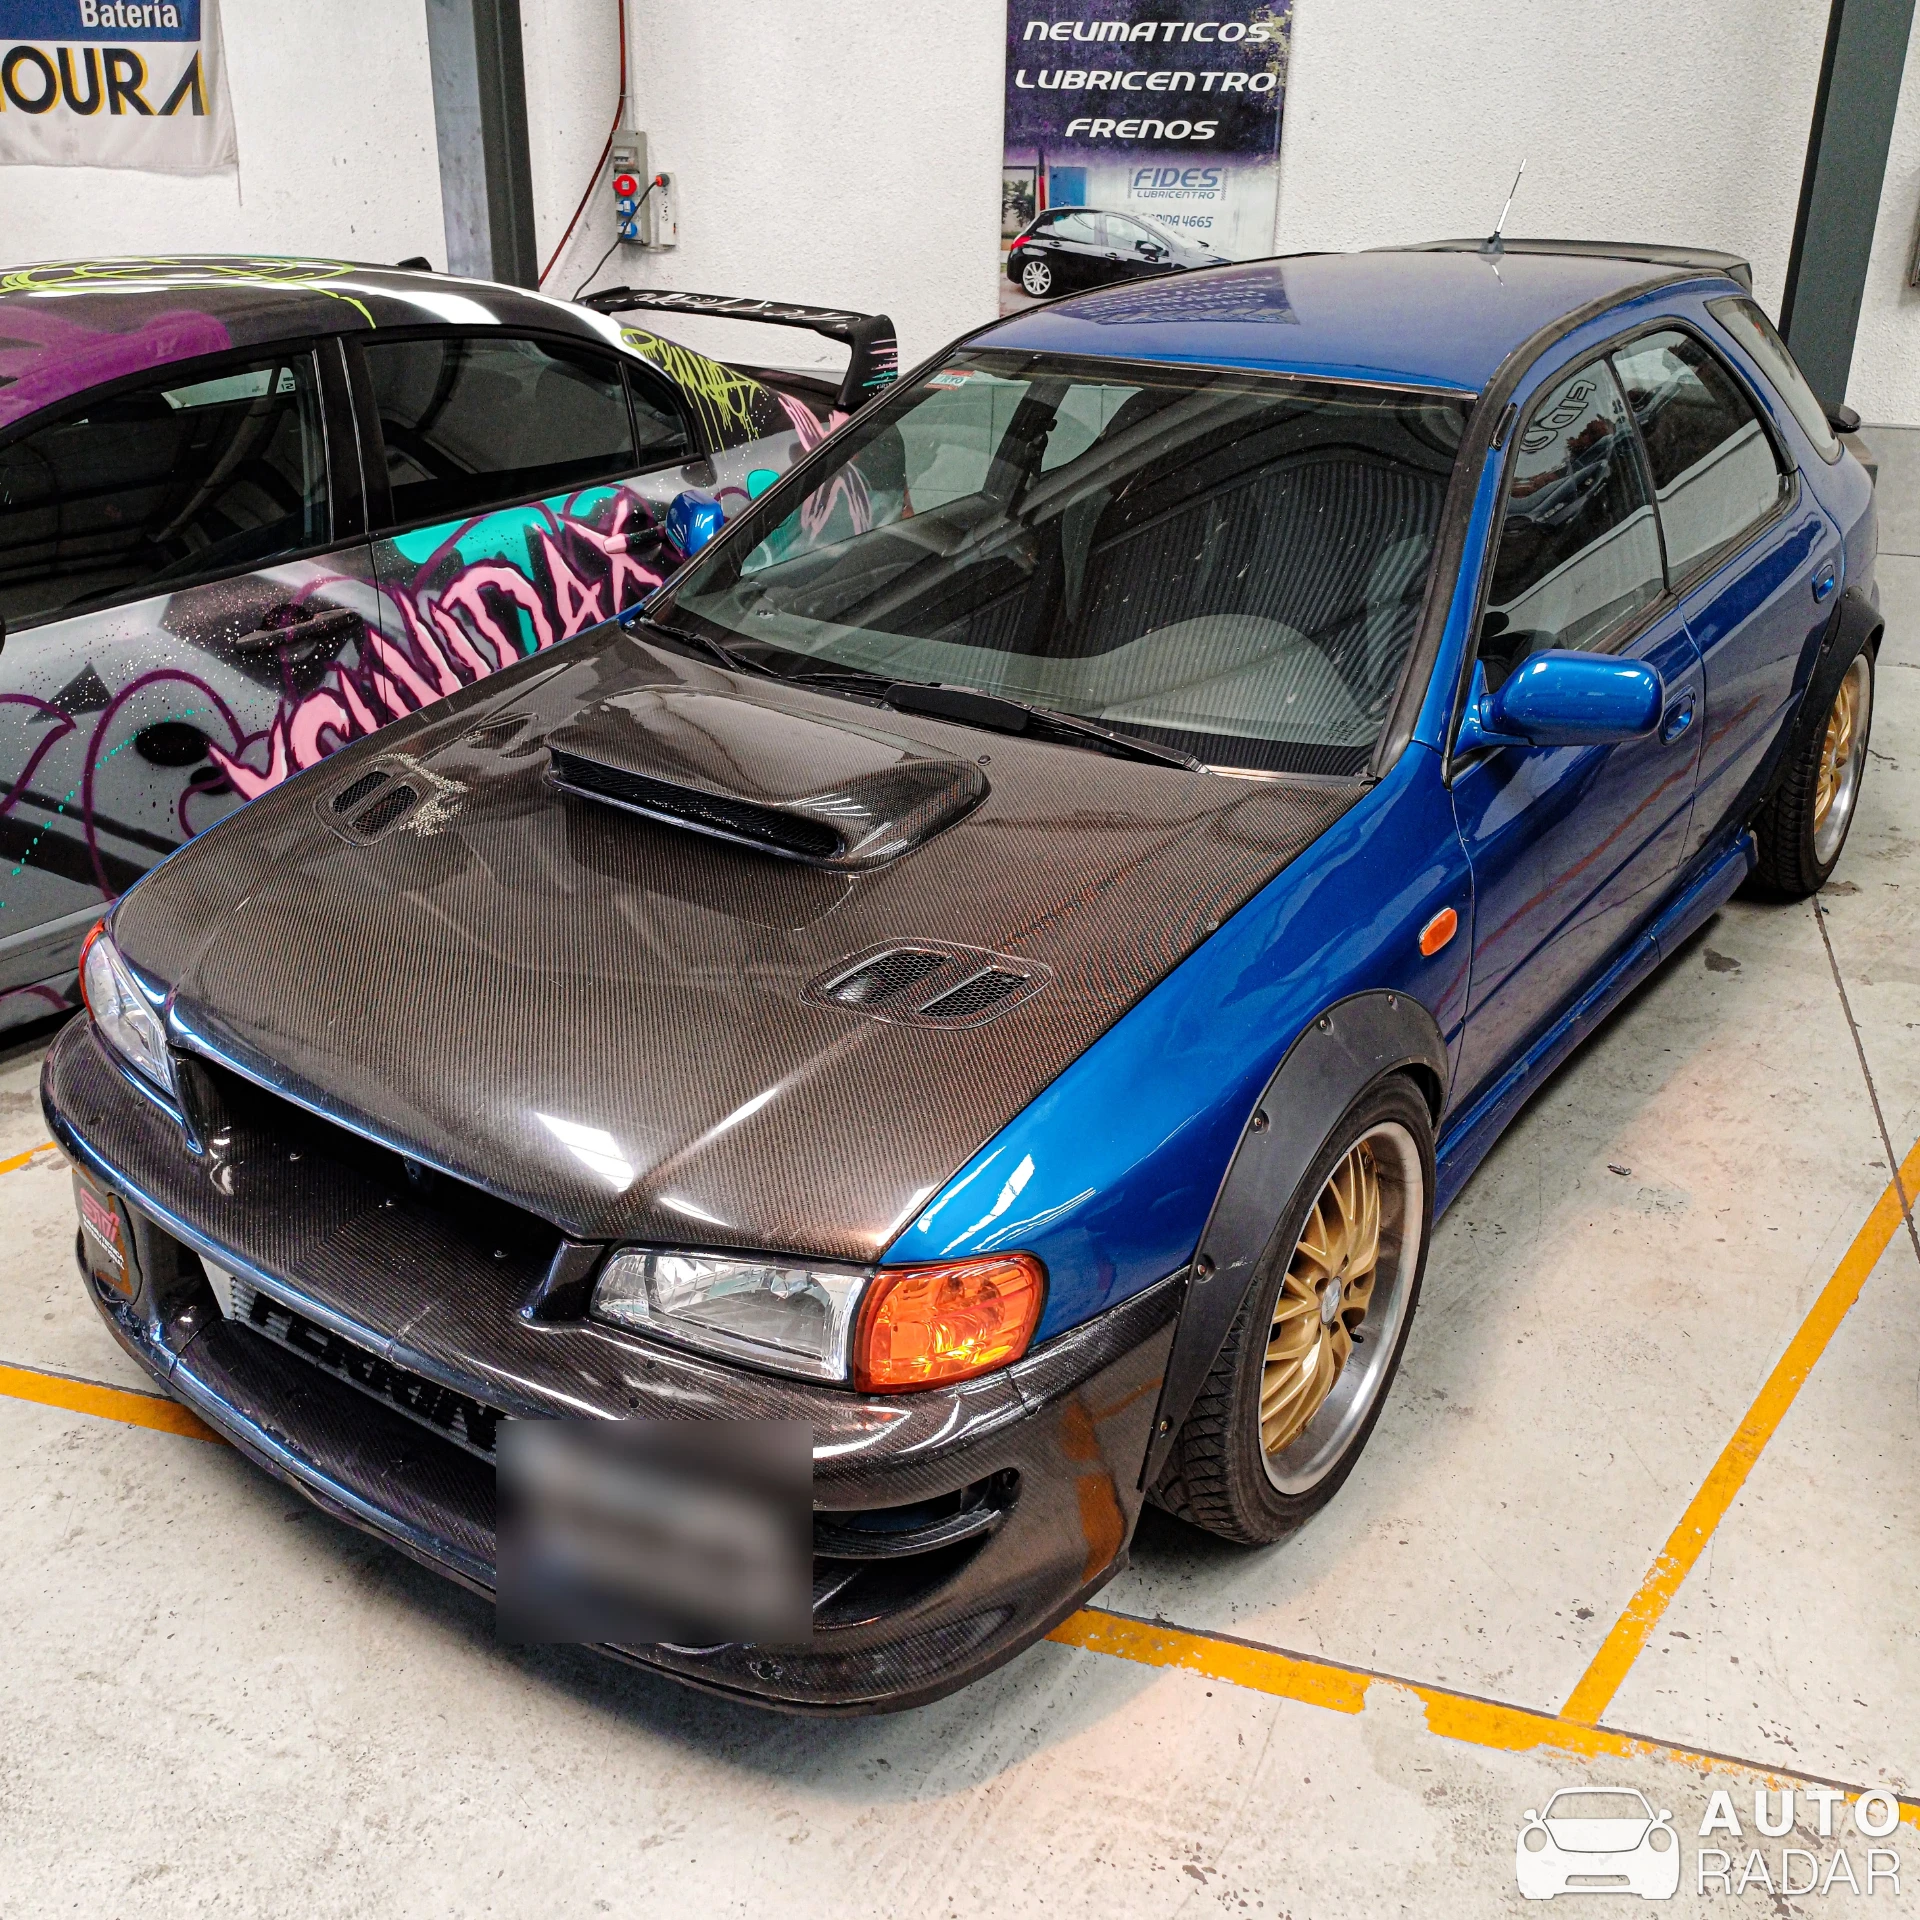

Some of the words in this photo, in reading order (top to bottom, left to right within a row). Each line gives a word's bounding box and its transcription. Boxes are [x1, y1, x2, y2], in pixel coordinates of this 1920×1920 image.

[79, 0, 178, 28] Batería
[1023, 22, 1274, 42] NEUMATICOS
[0, 45, 210, 116] OURA
[1014, 70, 1277, 92] LUBRICENTRO
[1065, 118, 1218, 140] FRENOS
[1133, 168, 1222, 187] FIDES
[1137, 191, 1215, 200] LUBRICENTRO
[1182, 215, 1214, 228] 4665
